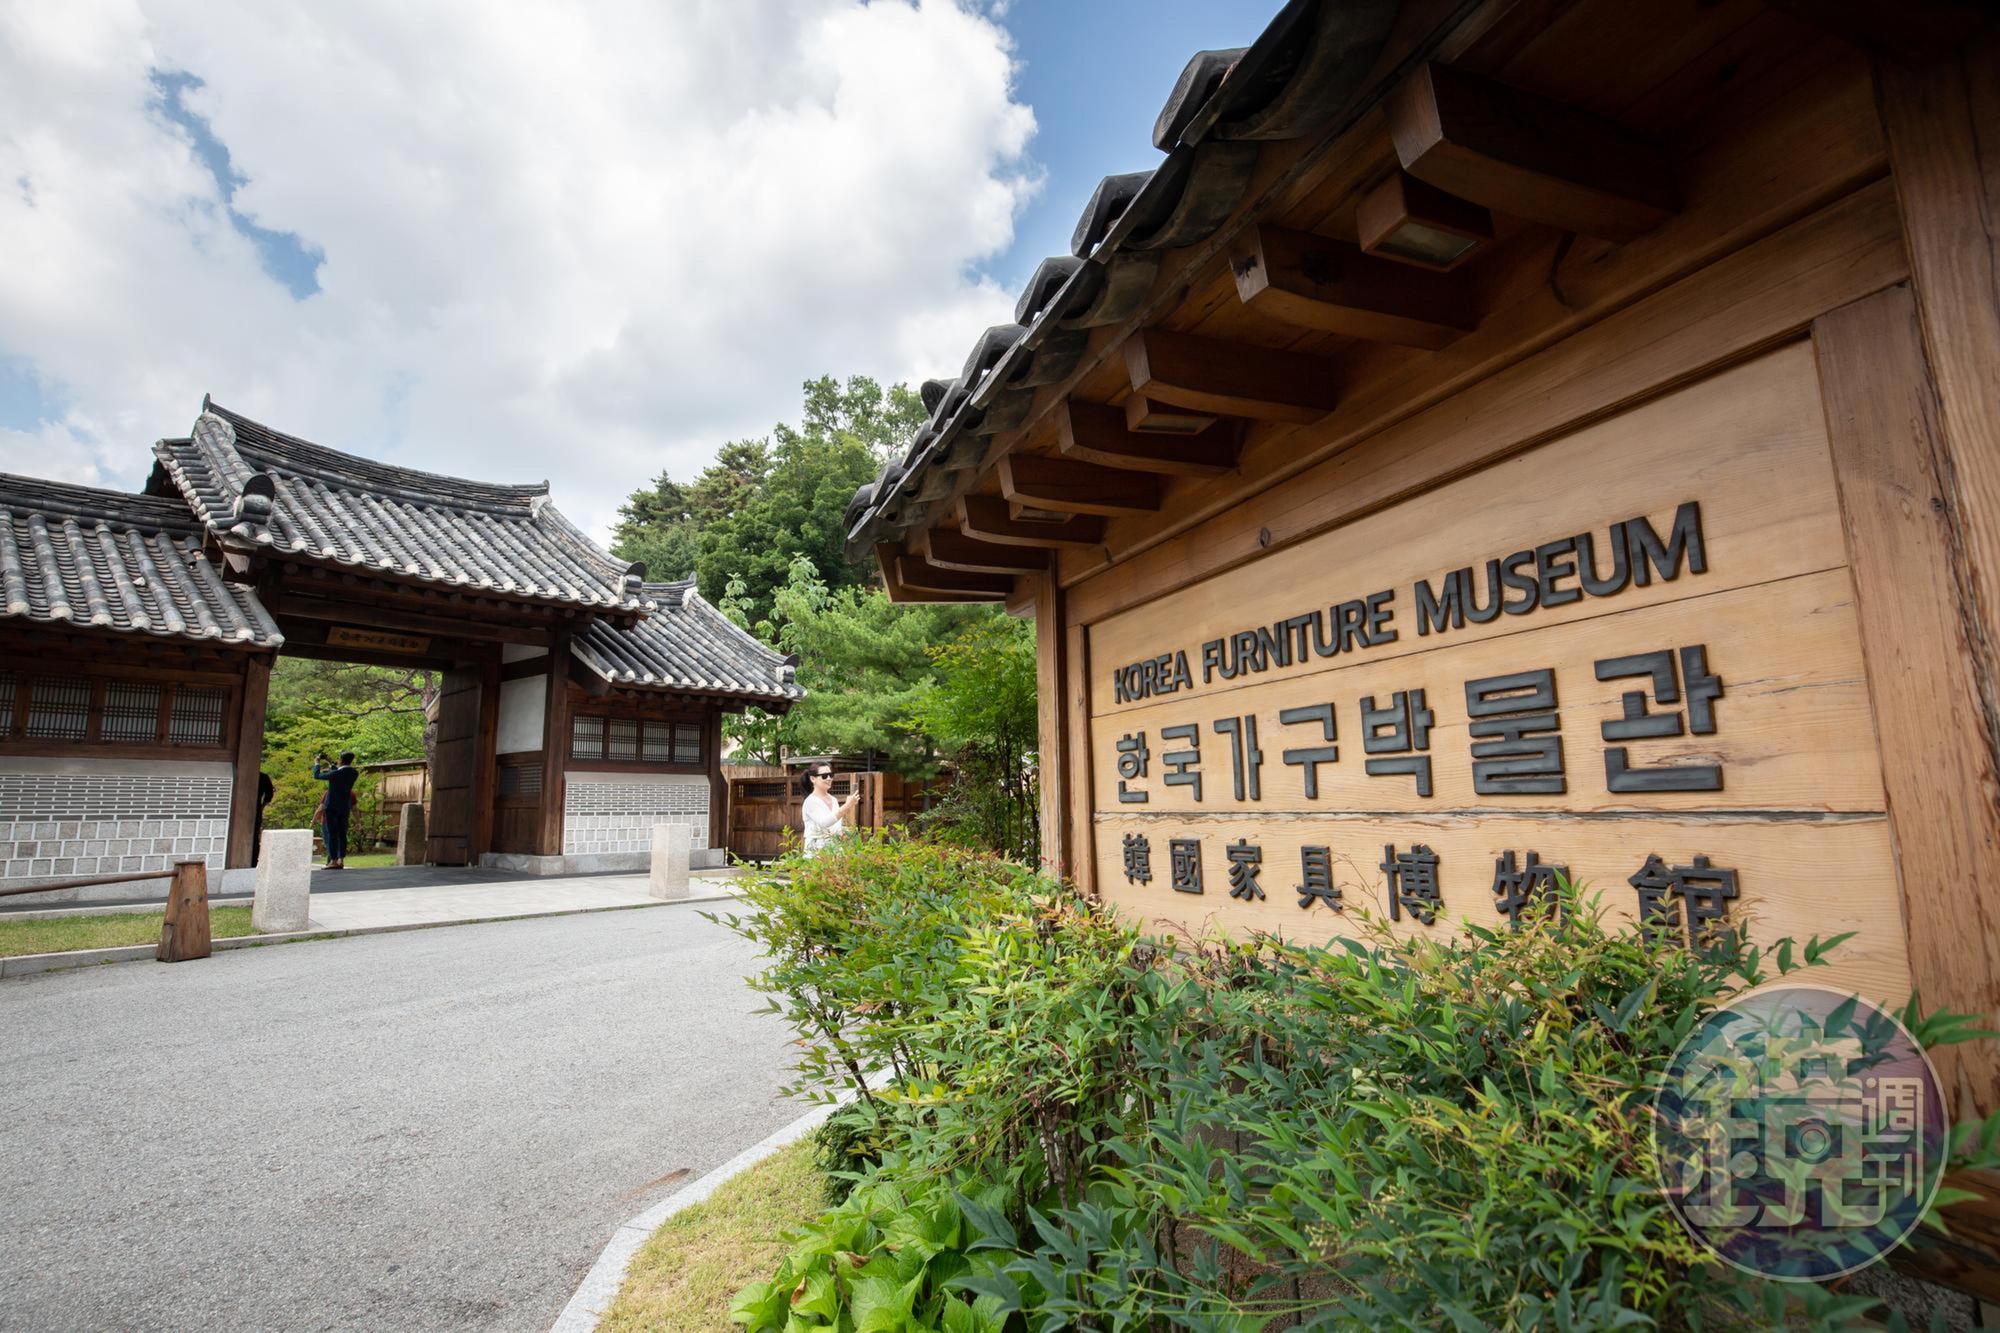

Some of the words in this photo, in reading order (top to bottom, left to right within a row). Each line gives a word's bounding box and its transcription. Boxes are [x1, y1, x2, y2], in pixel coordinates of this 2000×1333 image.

[1114, 650, 1192, 704] KOREA
[1202, 589, 1397, 683] FURNITURE
[1414, 501, 1707, 636] MUSEUM
[1117, 644, 1723, 803] 한국가구박물관
[1122, 833, 1740, 955] 韓國家具博物館
